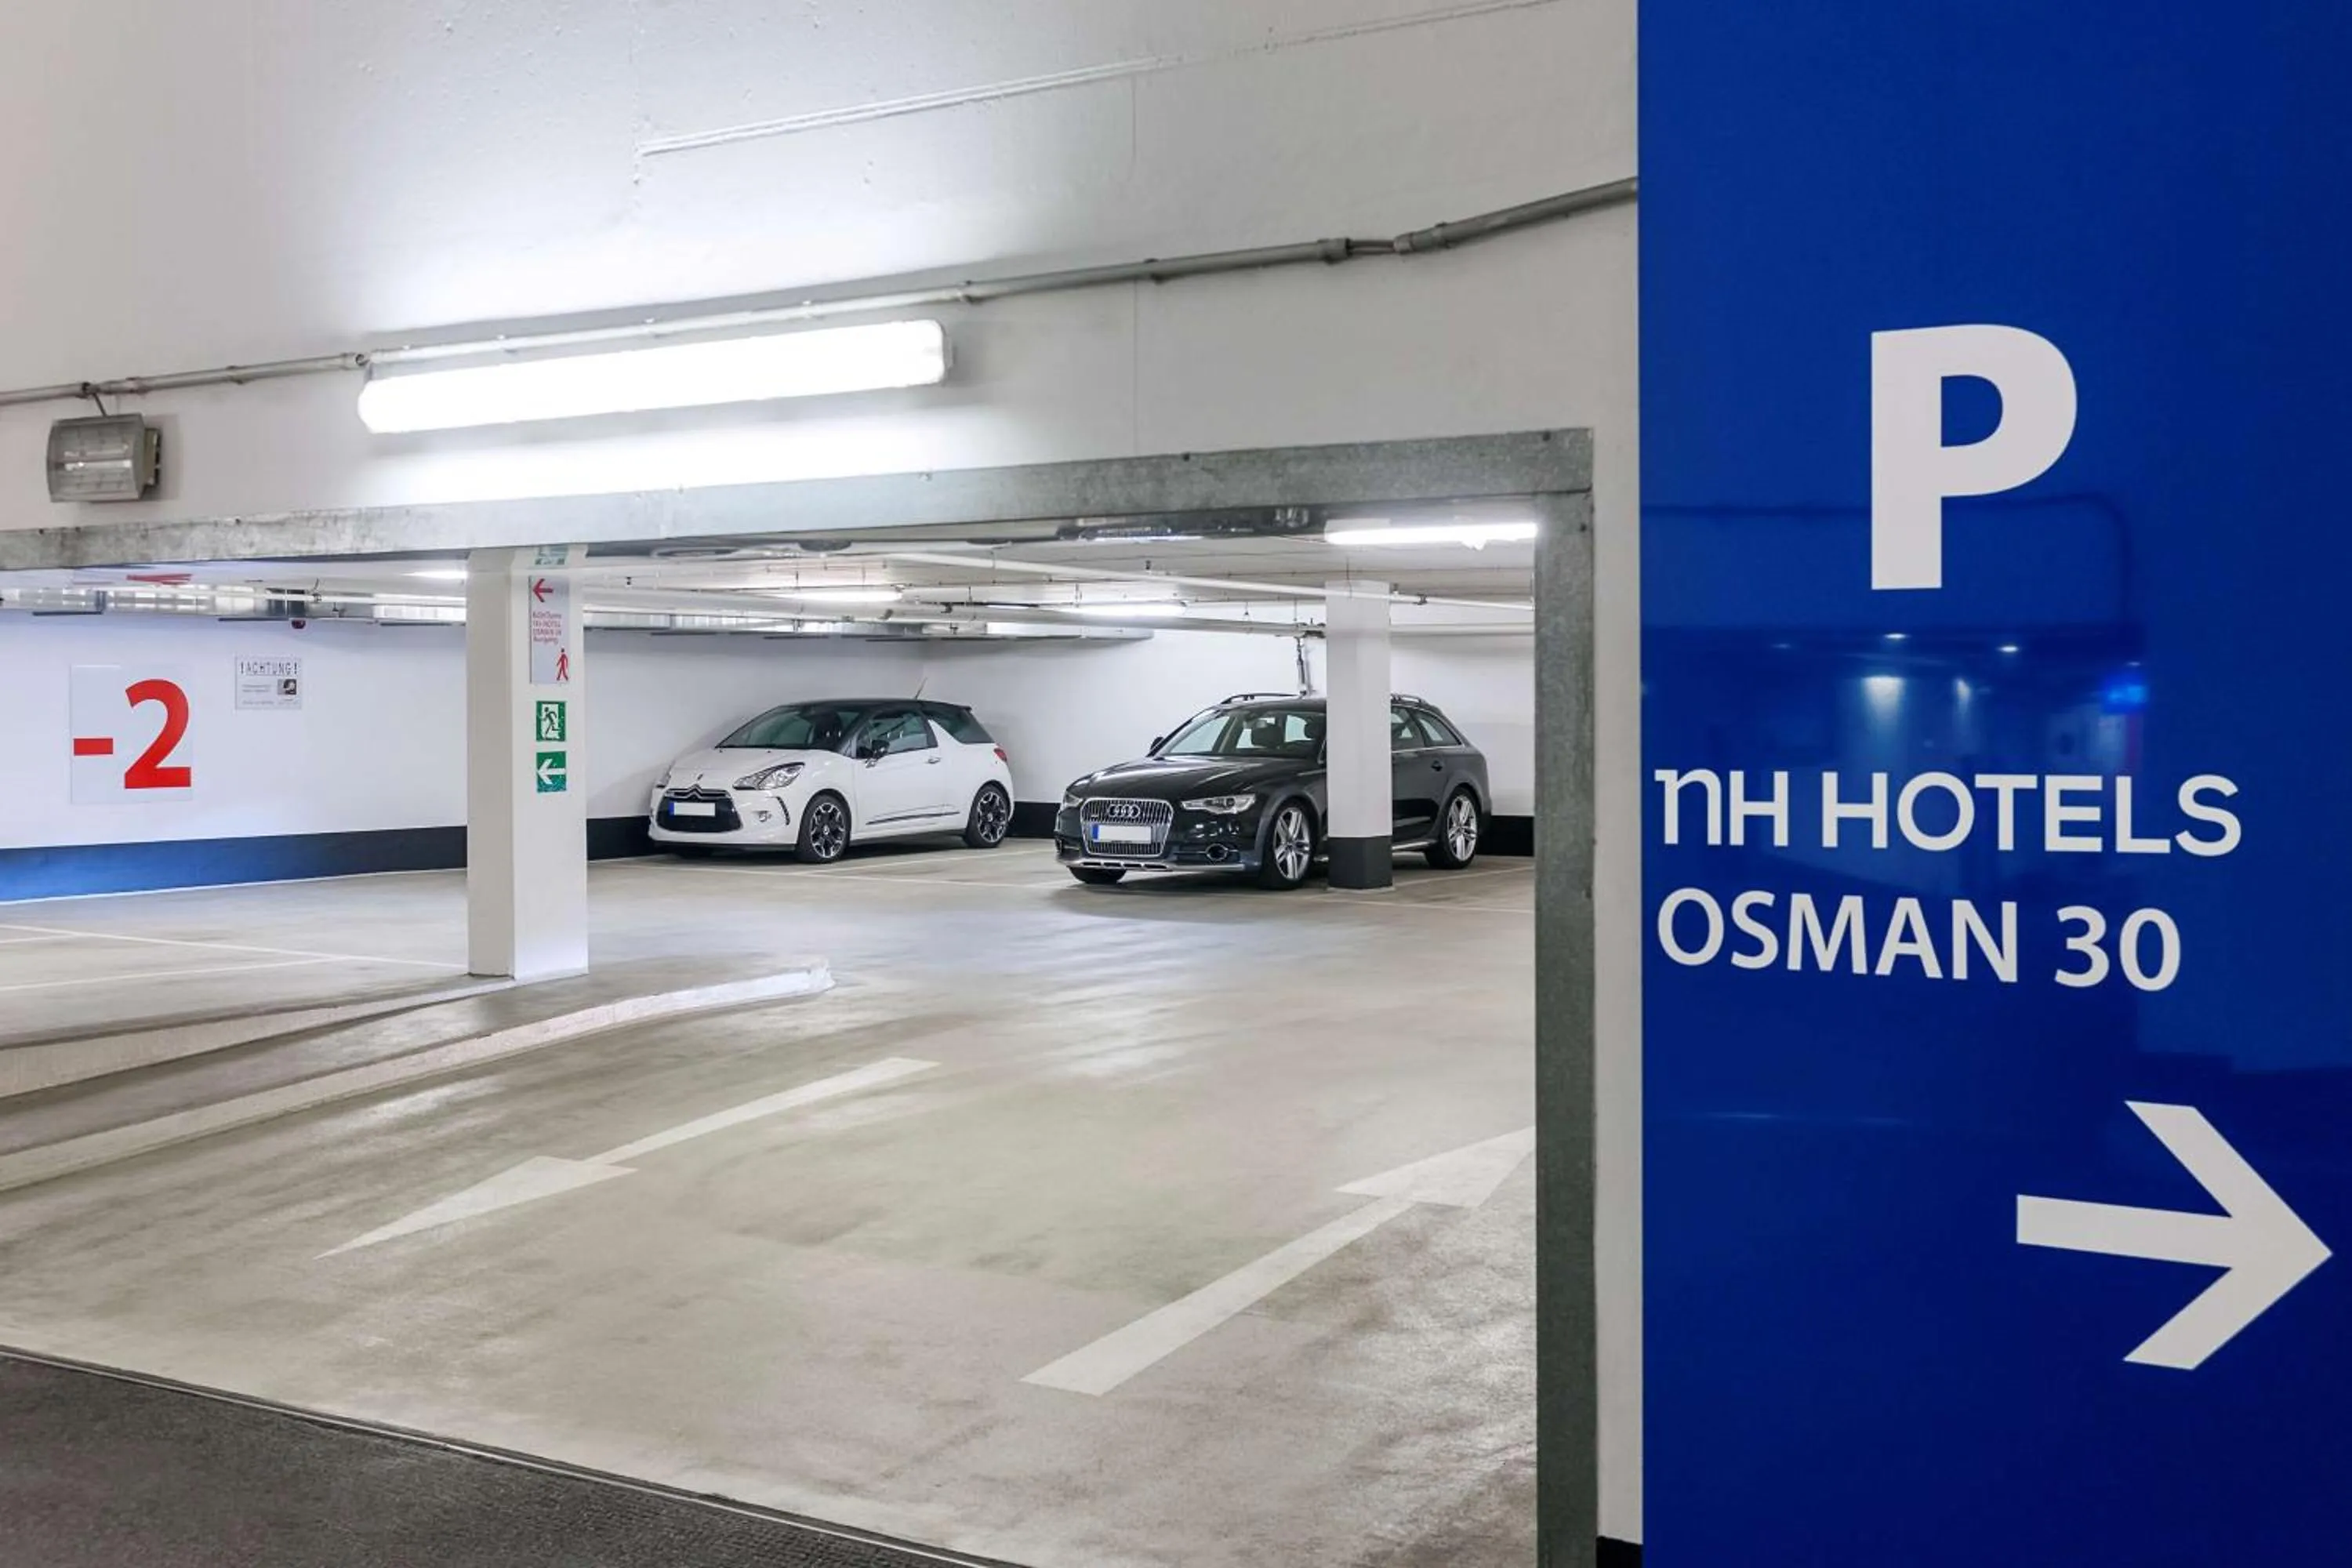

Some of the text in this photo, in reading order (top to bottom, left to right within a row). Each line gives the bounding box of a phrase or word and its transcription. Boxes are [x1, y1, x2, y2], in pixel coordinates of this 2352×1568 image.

[1871, 324, 2077, 590] P
[74, 679, 191, 789] -2
[1822, 772, 2241, 856] HOTELS
[1658, 887, 2180, 991] OSMAN 30
